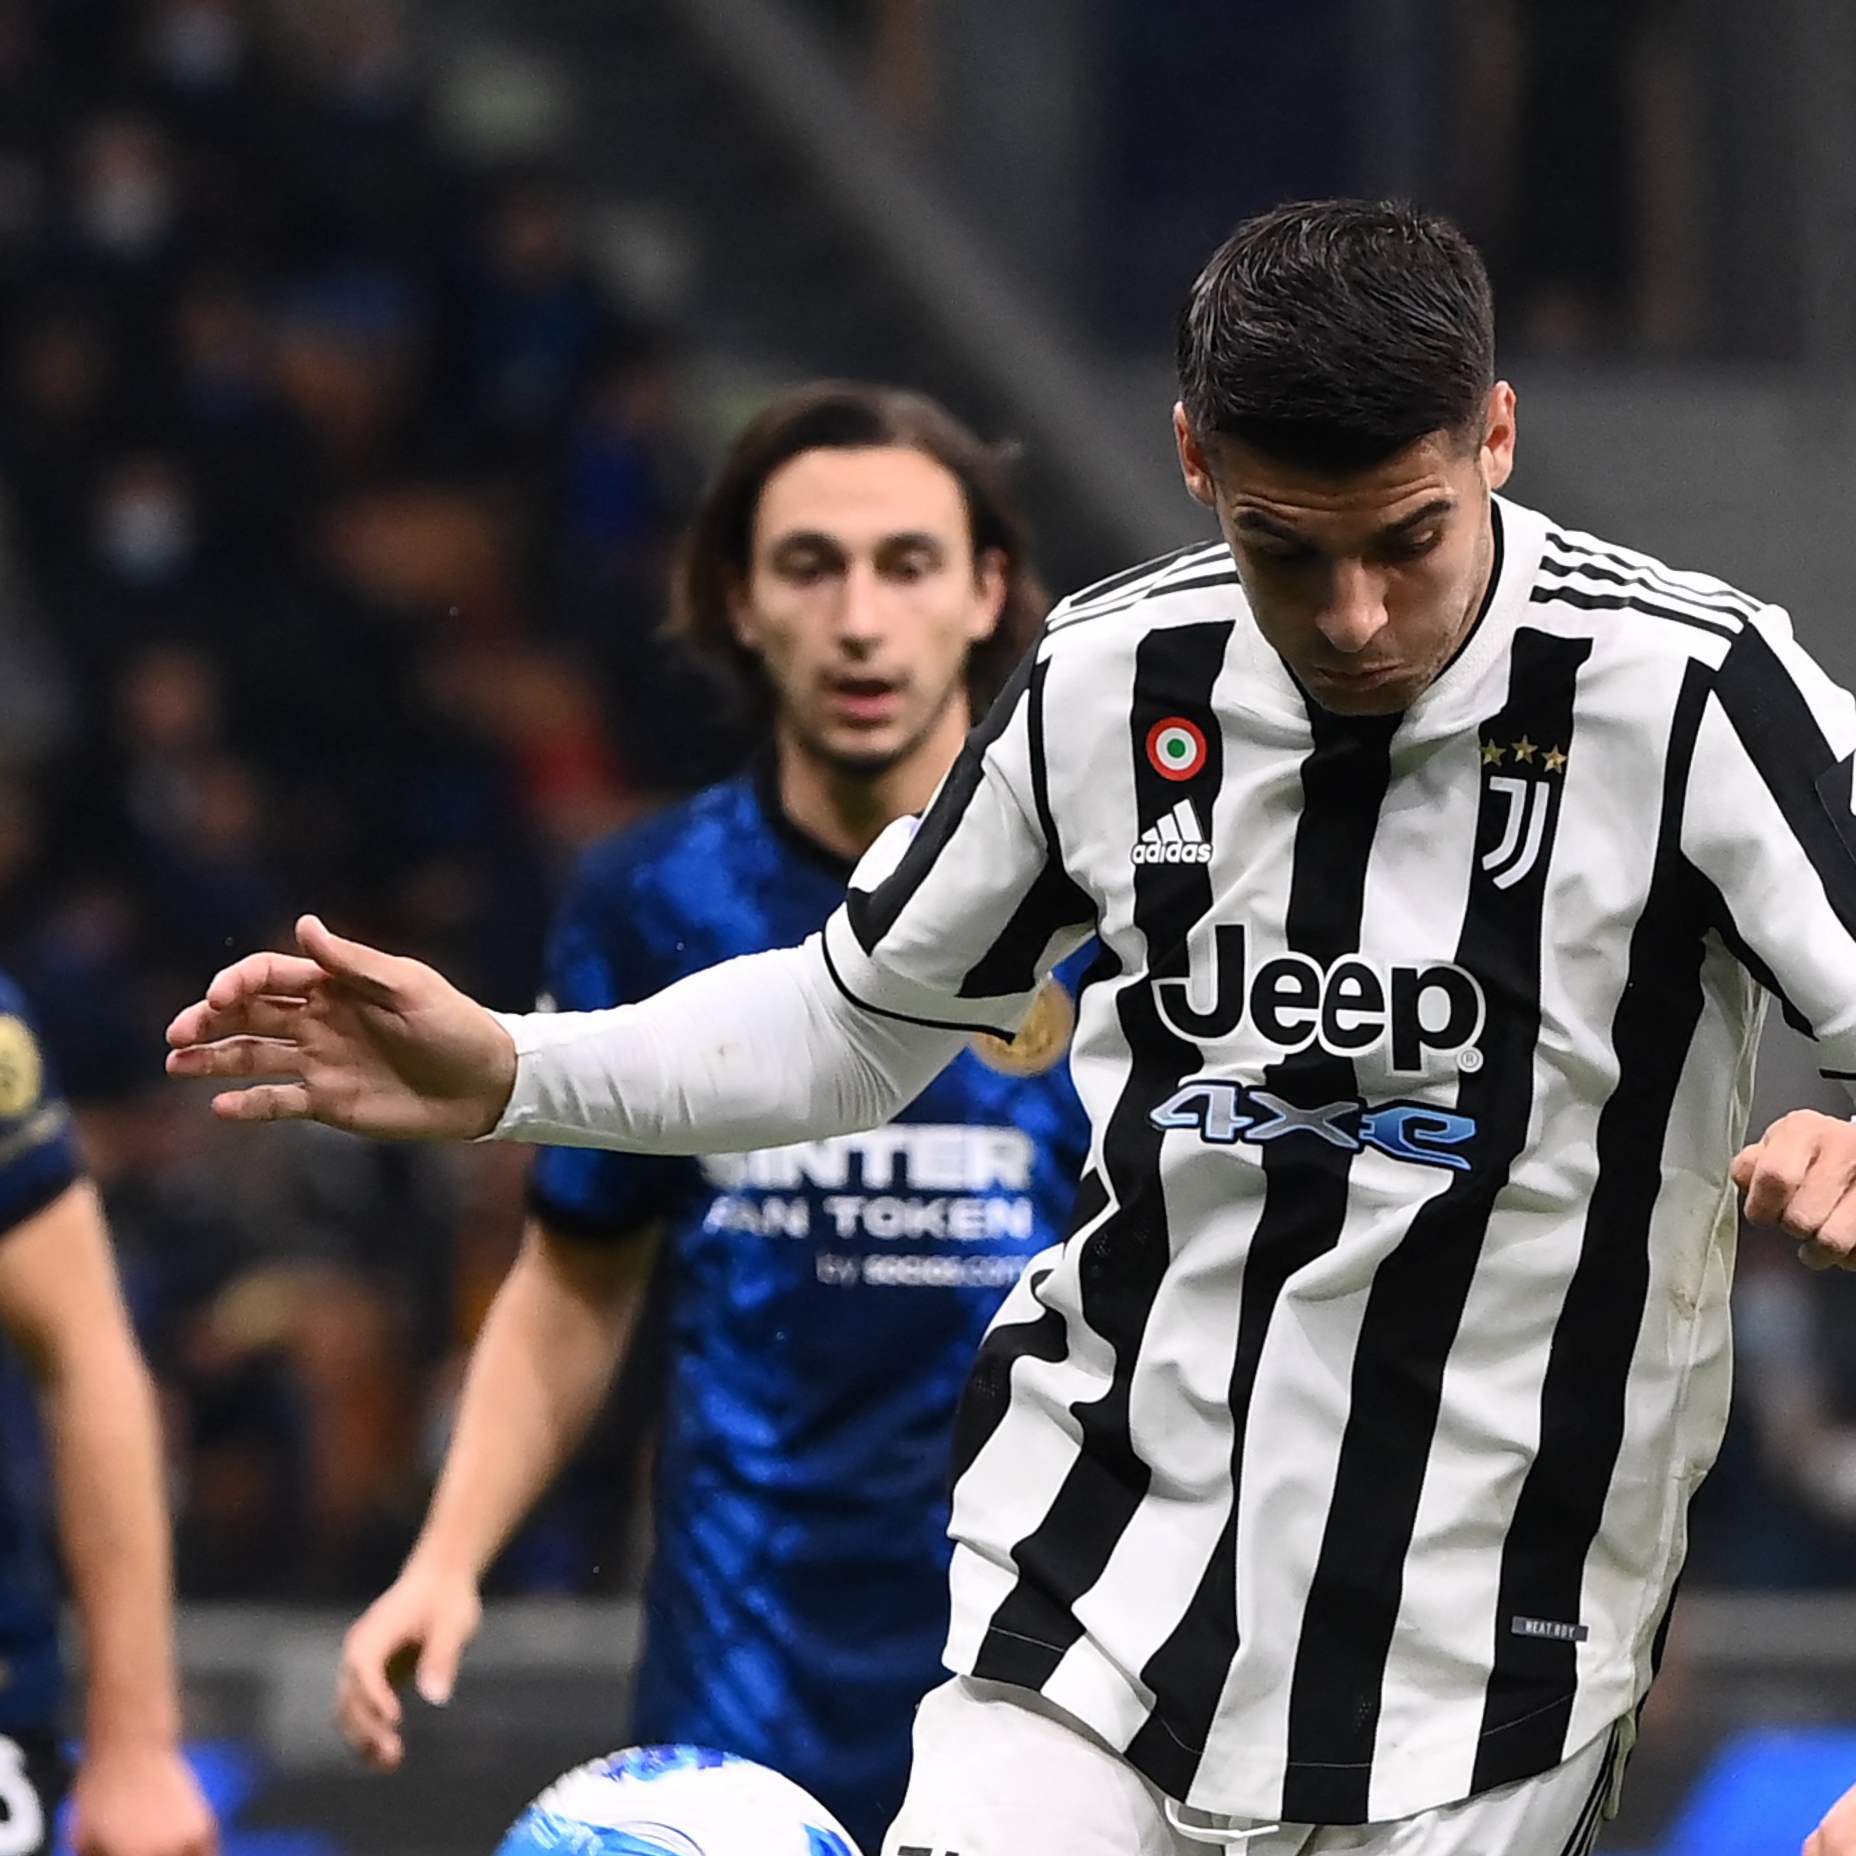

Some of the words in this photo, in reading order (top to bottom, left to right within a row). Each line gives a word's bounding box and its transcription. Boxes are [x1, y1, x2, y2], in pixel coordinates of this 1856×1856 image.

[1132, 840, 1212, 864] adidas
[1152, 922, 1486, 1076] Jeep
[822, 1196, 1035, 1243] TOKEN
